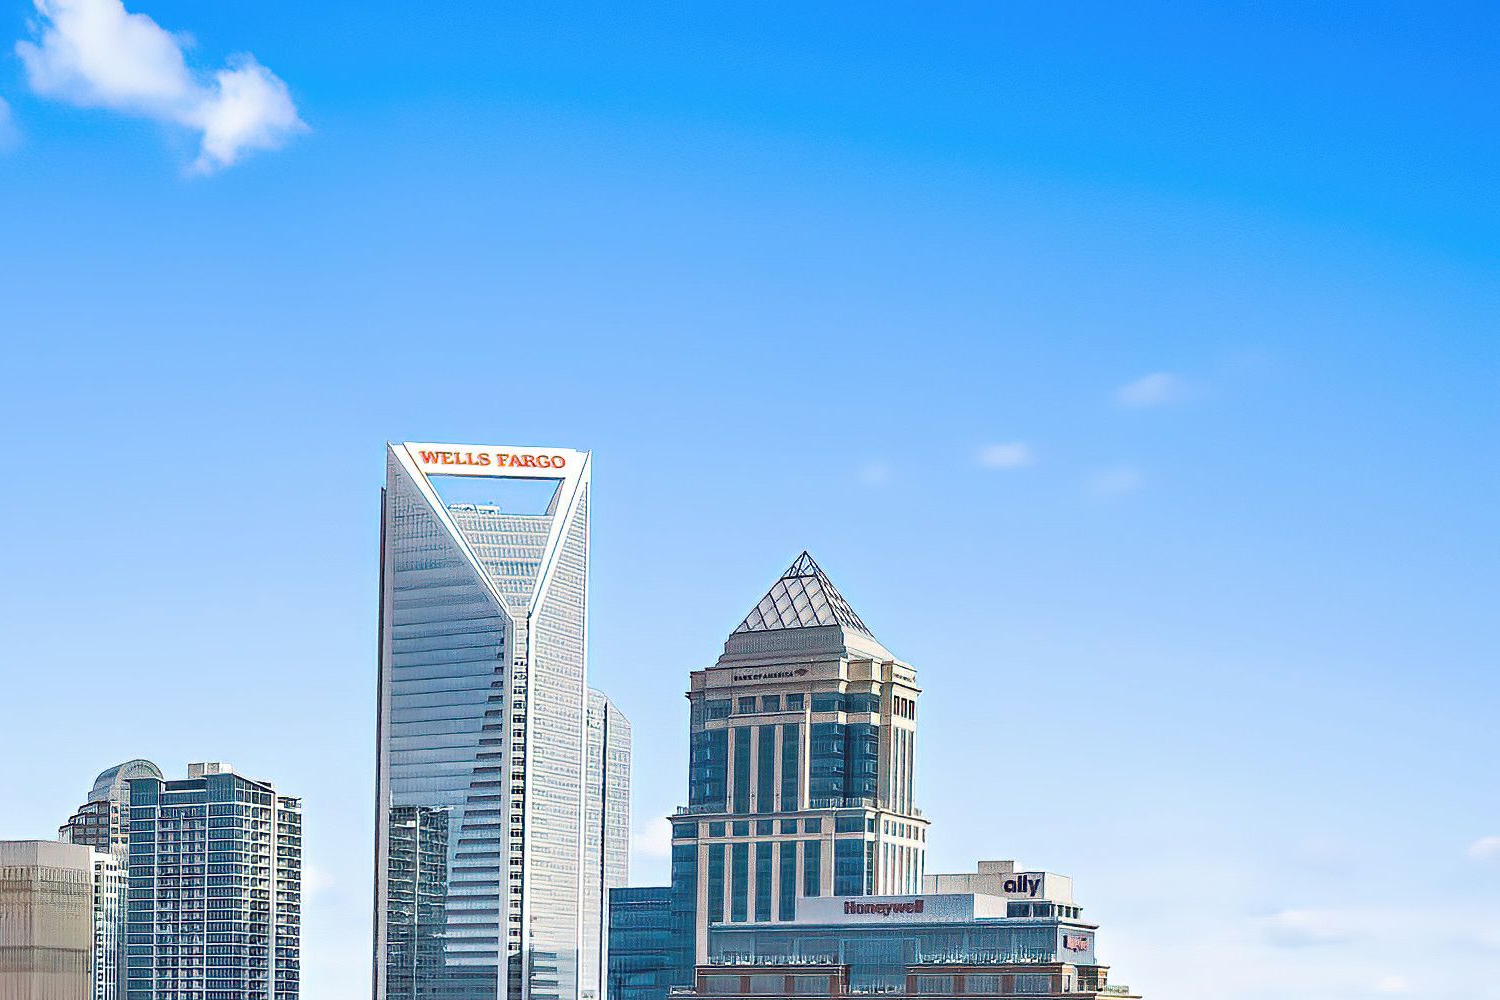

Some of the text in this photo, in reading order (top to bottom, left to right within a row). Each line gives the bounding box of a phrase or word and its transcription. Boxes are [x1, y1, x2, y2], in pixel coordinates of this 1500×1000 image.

[420, 451, 566, 469] WELLS FARGO
[763, 671, 793, 679] AMICA
[1003, 874, 1041, 897] ally
[844, 899, 924, 917] Honeywell
